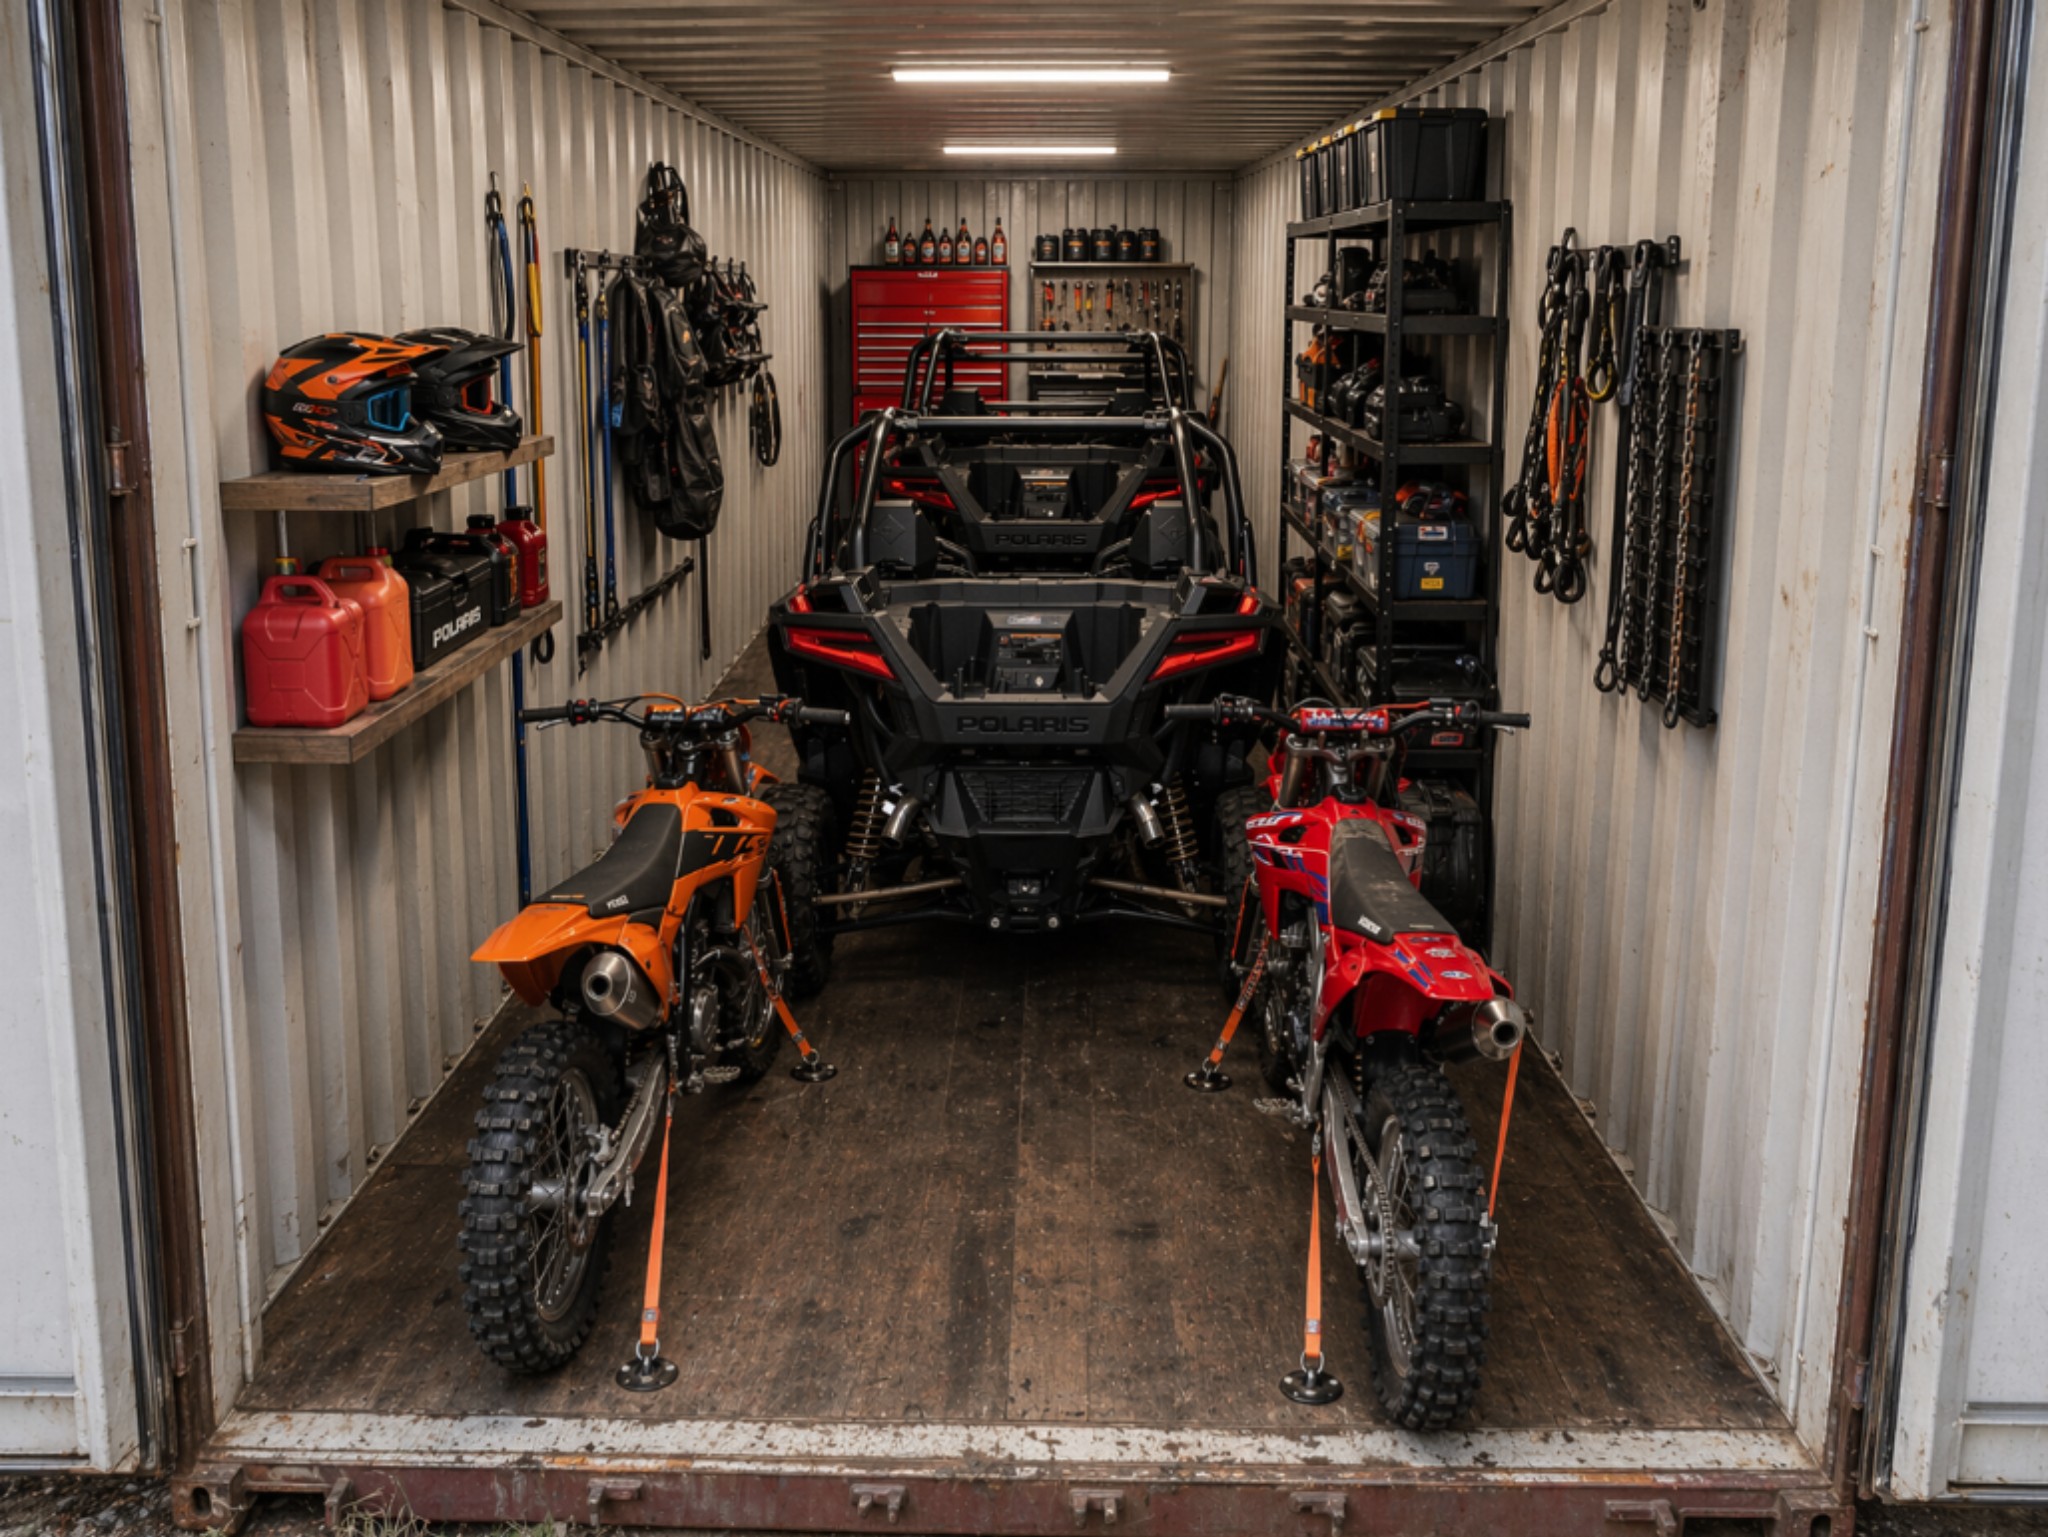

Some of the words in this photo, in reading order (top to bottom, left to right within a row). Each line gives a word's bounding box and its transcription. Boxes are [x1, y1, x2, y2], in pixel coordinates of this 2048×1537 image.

[995, 534, 1087, 545] POLARIS
[432, 605, 482, 648] POLARIS
[957, 716, 1089, 733] POLARIS
